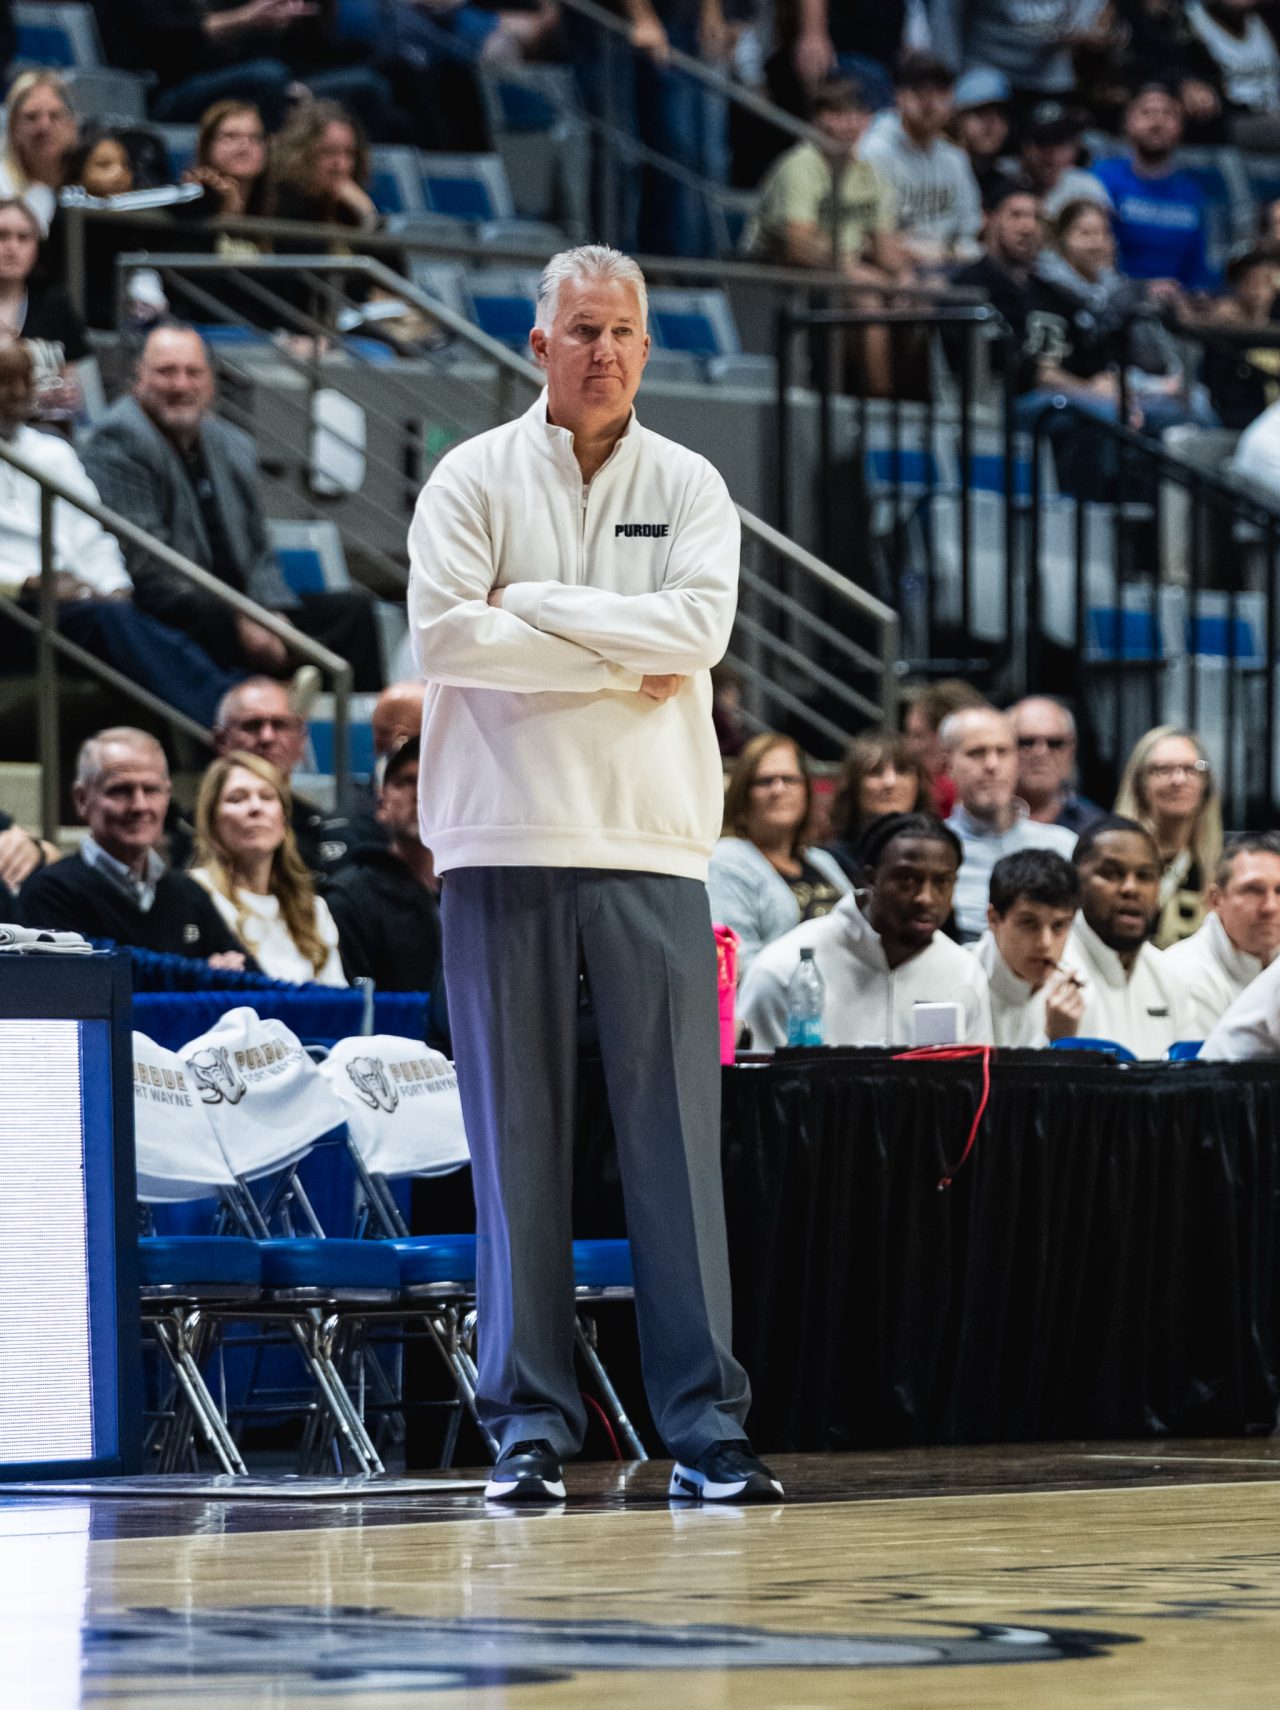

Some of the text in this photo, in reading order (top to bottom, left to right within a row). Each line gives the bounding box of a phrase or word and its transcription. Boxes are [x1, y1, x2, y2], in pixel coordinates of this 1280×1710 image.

[614, 524, 670, 538] PURDUE
[400, 1076, 458, 1098] FORT WAYN
[151, 1088, 194, 1108] WAYNE
